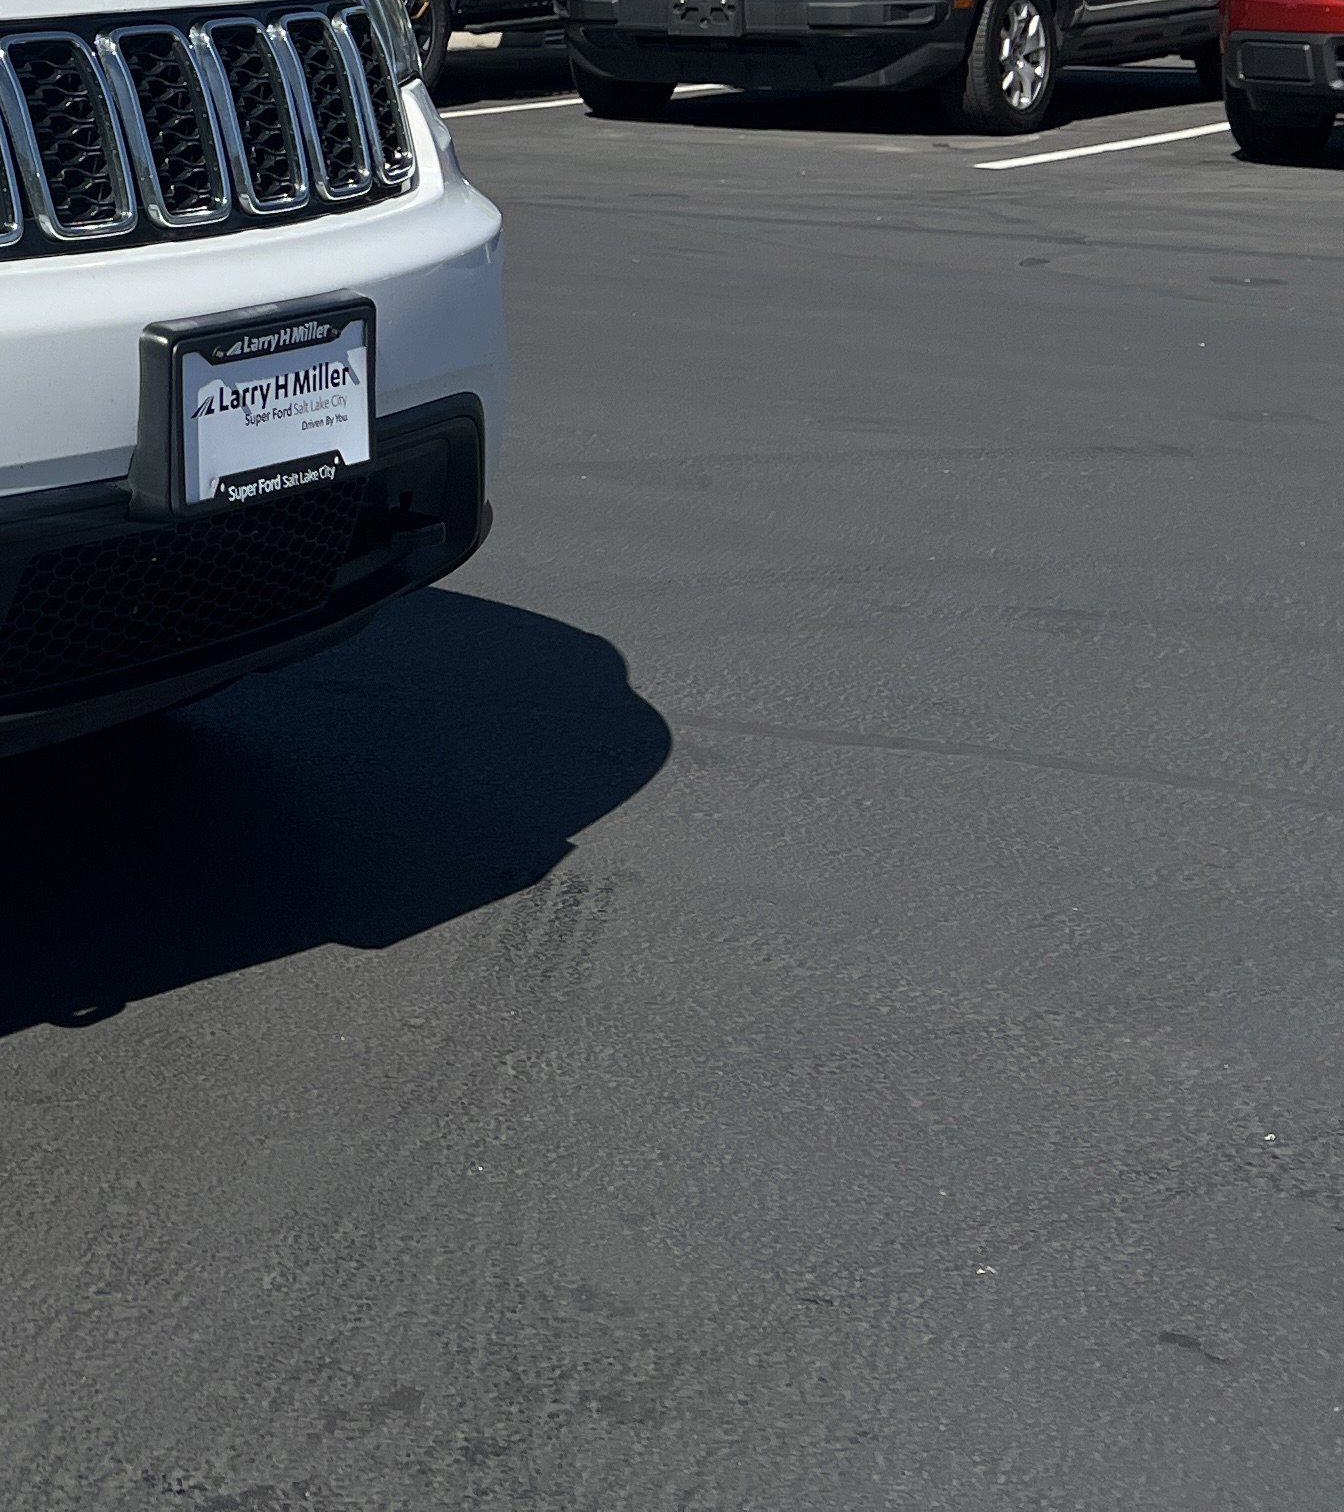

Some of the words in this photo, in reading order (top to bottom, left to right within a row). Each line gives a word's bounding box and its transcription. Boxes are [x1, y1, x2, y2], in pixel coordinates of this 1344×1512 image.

[243, 334, 279, 354] Larry
[279, 329, 291, 346] H
[291, 321, 330, 344] Miller
[219, 383, 272, 413] Larry
[274, 374, 288, 400] H
[293, 362, 350, 396] Miller
[244, 412, 272, 427] Super
[272, 403, 293, 420] Ford
[293, 399, 309, 415] Salt
[310, 397, 330, 412] Lake
[331, 394, 348, 409] City
[301, 417, 325, 431] Driven
[325, 415, 335, 427] By
[228, 483, 259, 503] Super
[258, 474, 282, 494] Ford
[282, 473, 299, 489] Salt
[299, 469, 319, 485] Lake
[318, 464, 337, 481] City
